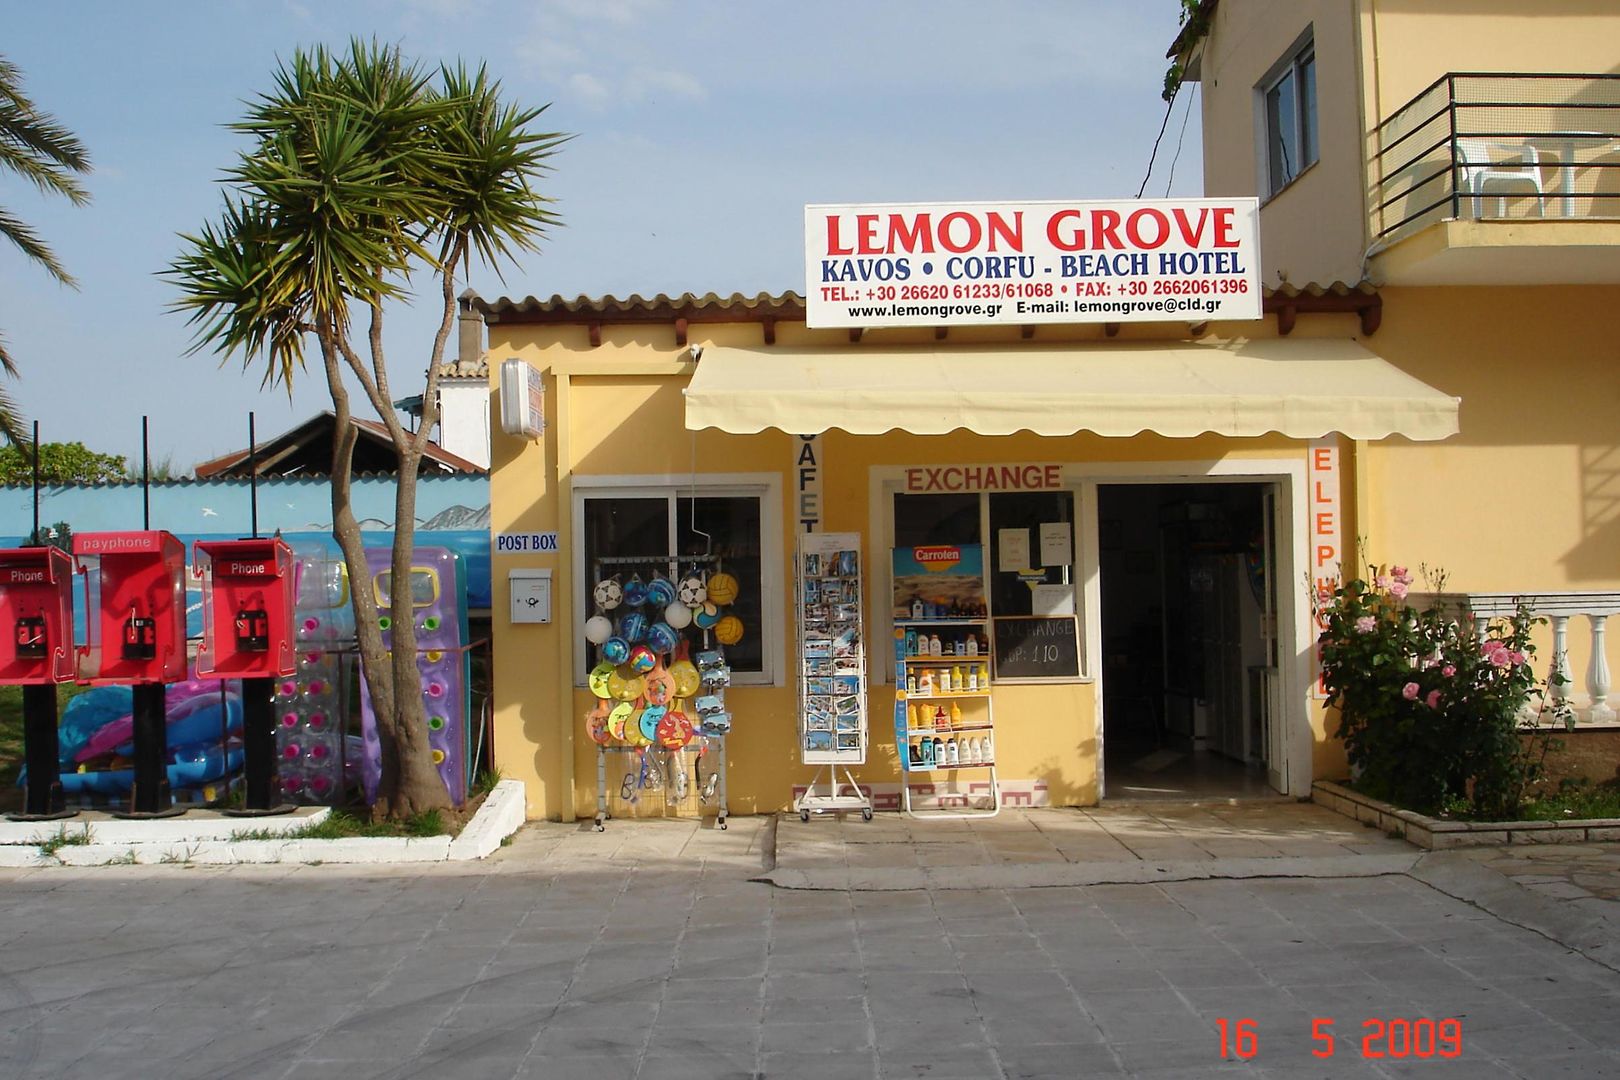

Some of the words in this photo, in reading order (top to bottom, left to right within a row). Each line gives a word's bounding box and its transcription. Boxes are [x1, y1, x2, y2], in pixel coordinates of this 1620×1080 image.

[826, 211, 1024, 256] LEMON
[1046, 208, 1241, 251] GROVE
[821, 257, 911, 282] KAVOS
[946, 256, 1035, 279] CORFU
[1060, 252, 1149, 278] BEACH
[1159, 251, 1246, 275] HOTEL
[821, 286, 860, 302] TEL.:
[866, 286, 896, 301] +30
[901, 285, 949, 300] 26620
[953, 282, 1053, 300] 61233/61068
[1076, 281, 1111, 297] FAX:
[1118, 281, 1148, 296] +30
[1153, 279, 1248, 295] 2662061396
[848, 303, 1002, 318] www.lemongrove.gr
[1016, 300, 1069, 315] E-mail:
[1074, 298, 1222, 315] lemongrove@cld.gr
[907, 465, 1061, 491] EXCHANGE
[83, 538, 151, 551] payphone
[498, 535, 529, 551] POST
[532, 534, 557, 550] BOX
[915, 549, 960, 561] Carroten
[11, 570, 43, 582] Phone
[231, 562, 265, 574] Phone
